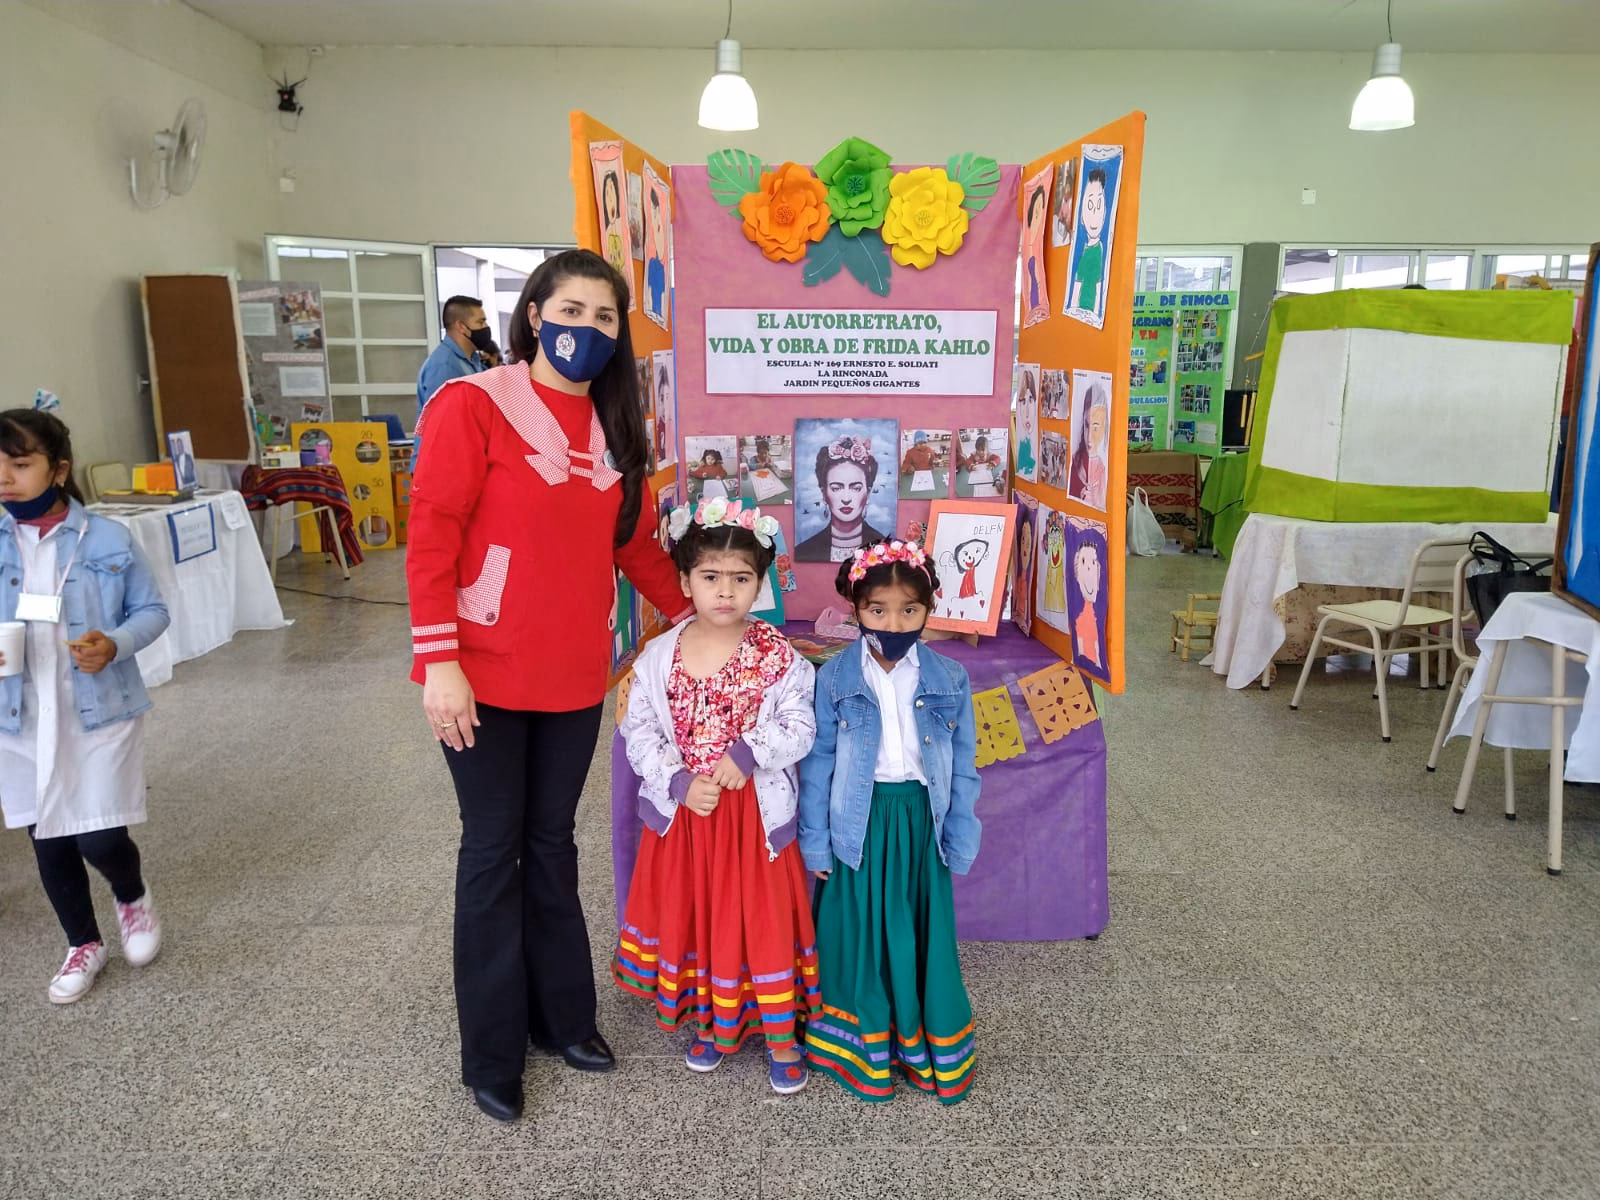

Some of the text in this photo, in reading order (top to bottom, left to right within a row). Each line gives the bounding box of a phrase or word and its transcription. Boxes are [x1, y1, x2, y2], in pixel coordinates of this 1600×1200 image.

[1160, 294, 1176, 307] DE
[1181, 294, 1229, 306] SIMOCA
[757, 313, 942, 333] EL AUTORRETRATO,
[708, 337, 990, 355] VIDA Y OBRA DE FRIDA KAHLO
[766, 360, 812, 368] ESCUELA:
[826, 361, 841, 369] 169
[843, 361, 886, 369] ERNESTO
[888, 361, 896, 369] E.
[898, 361, 938, 369] SOLDATI
[818, 370, 888, 378] LA RINCONADA
[783, 378, 920, 389] JARDIN PEQUEÑOS GIGANTES
